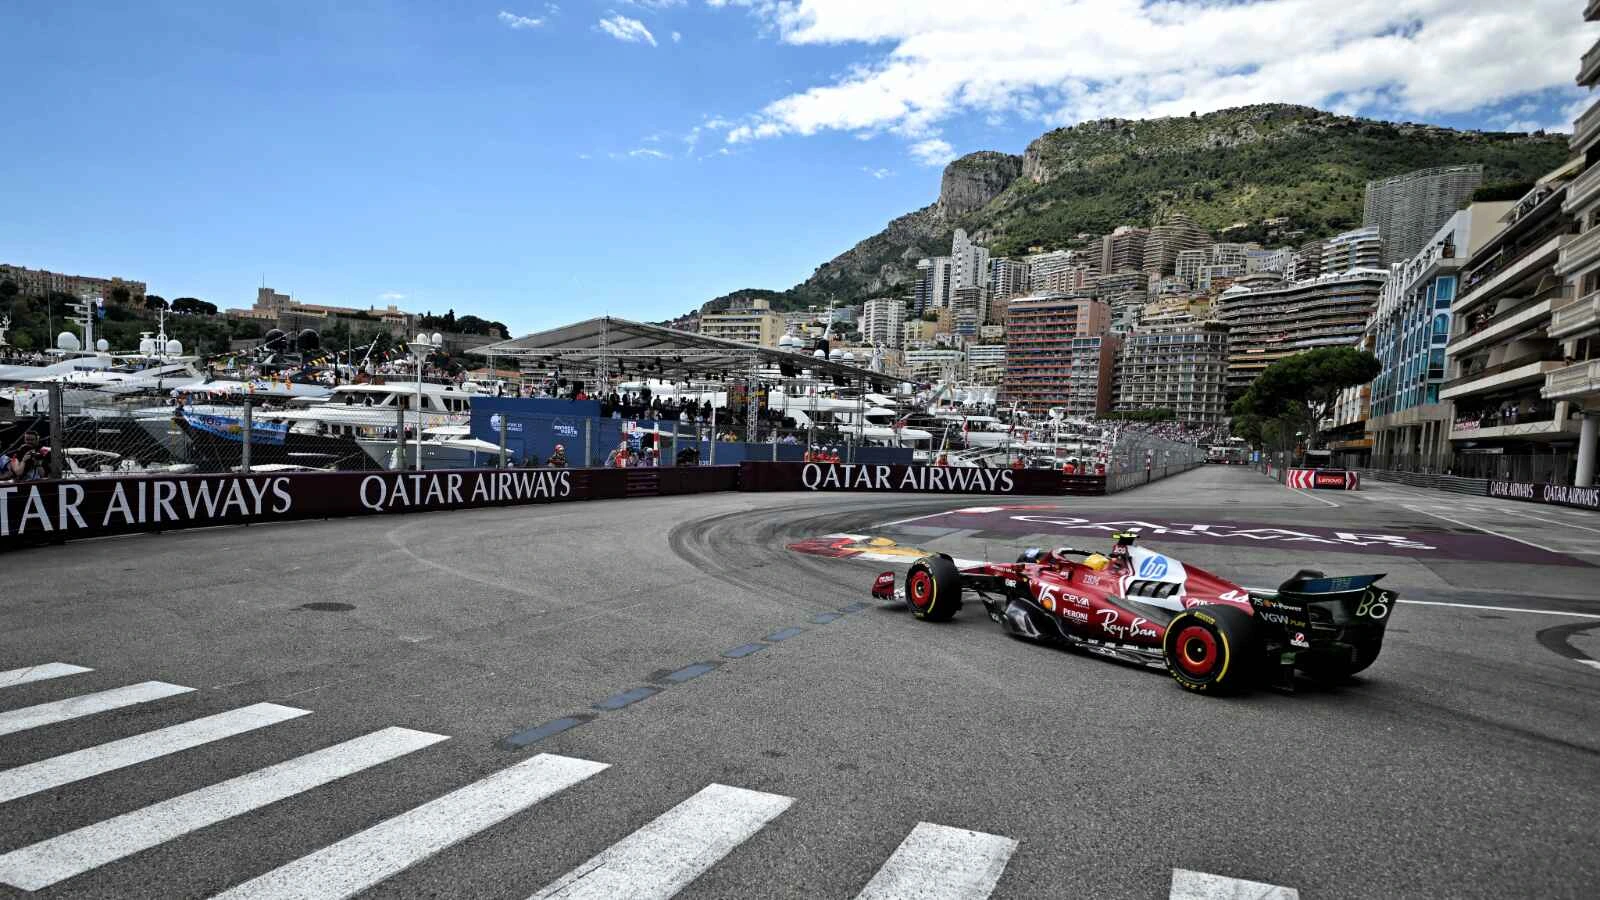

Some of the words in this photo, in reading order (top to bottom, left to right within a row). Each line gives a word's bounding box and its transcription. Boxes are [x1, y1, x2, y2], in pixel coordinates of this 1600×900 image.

[802, 463, 891, 490] QATAR
[899, 466, 1015, 492] AIRWAYS
[1318, 476, 1342, 484] Lenovo
[1490, 481, 1509, 496] QATAR
[1509, 483, 1535, 498] AIRWAYS
[102, 477, 292, 527] AIRWAYS
[359, 475, 464, 512] QATAR
[472, 471, 571, 502] AIRWAYS
[1543, 485, 1567, 502] QATAR
[1566, 487, 1599, 506] AIRWAYS
[1140, 555, 1168, 579] hp
[1096, 608, 1157, 640] Ray-Ban
[1259, 611, 1289, 624] VGW
